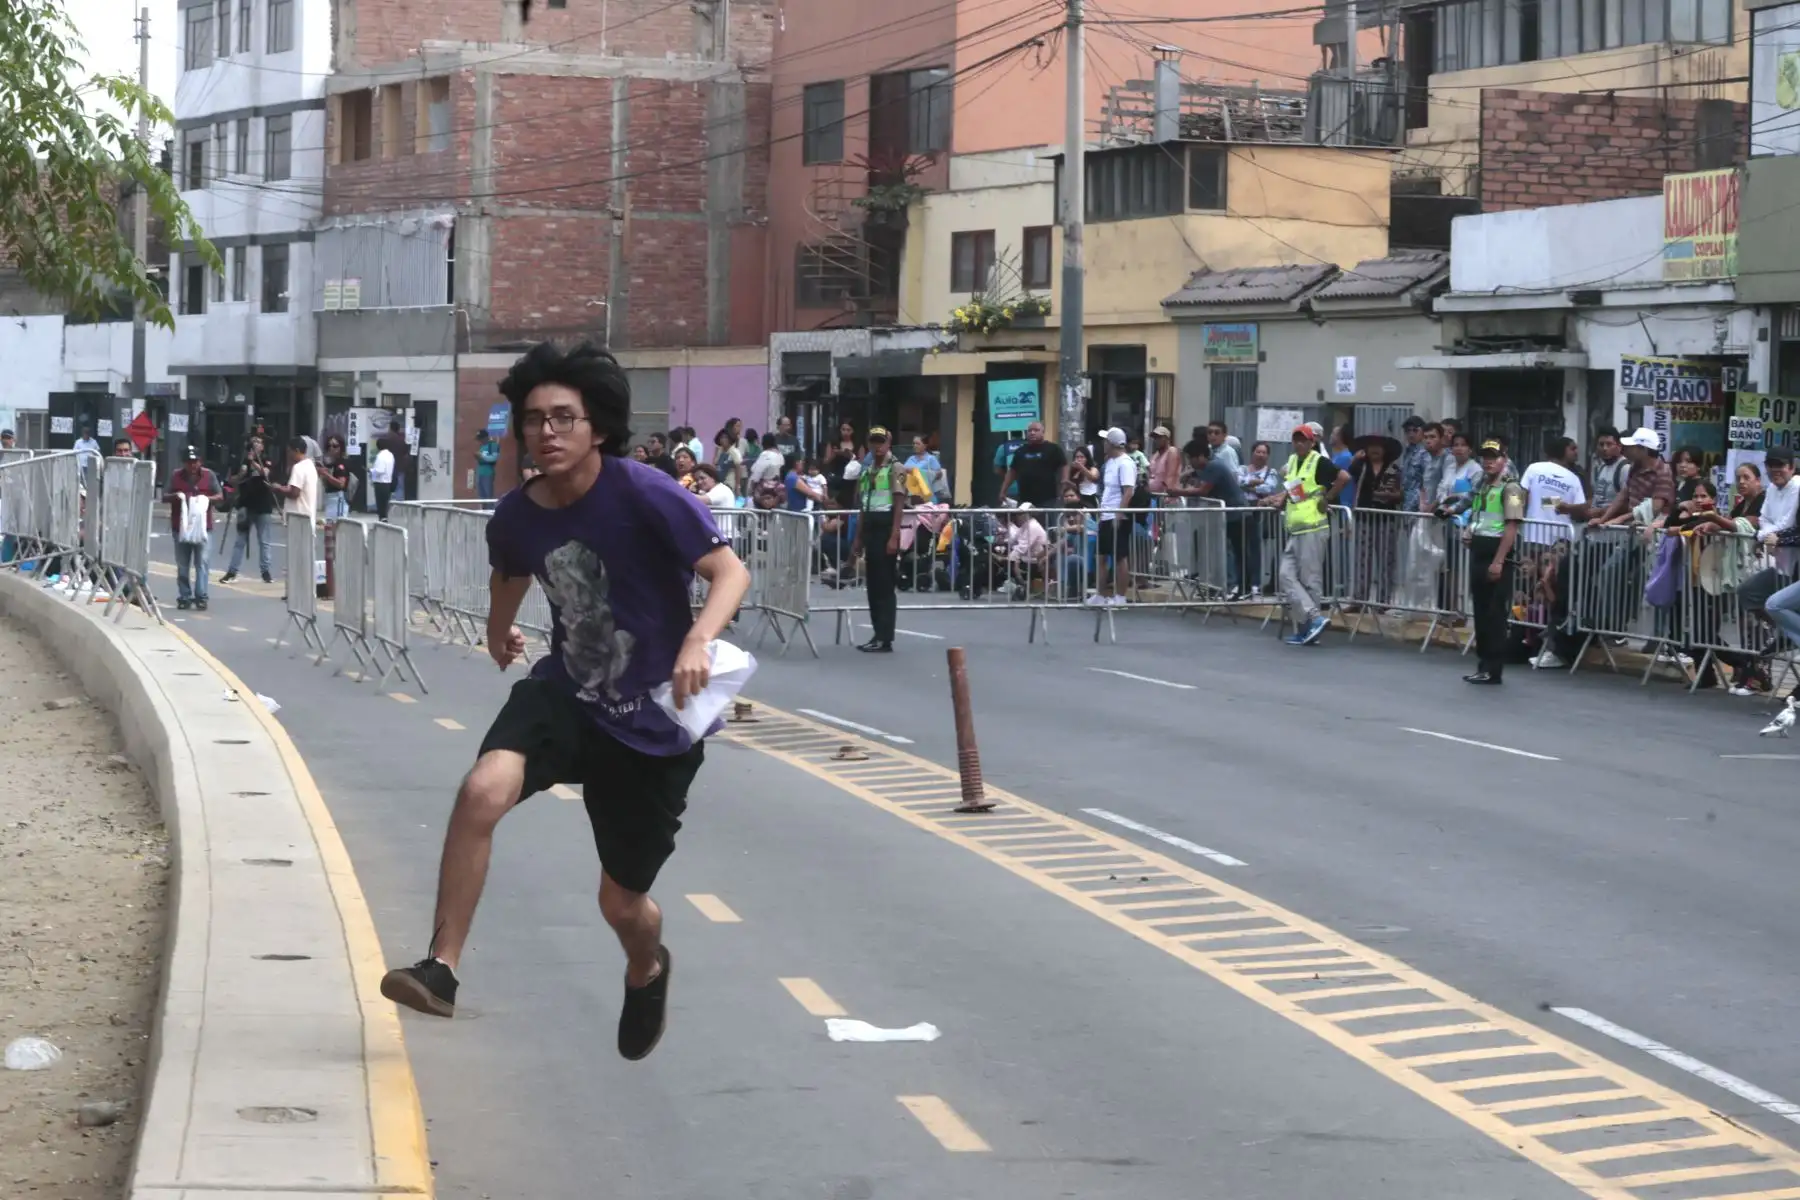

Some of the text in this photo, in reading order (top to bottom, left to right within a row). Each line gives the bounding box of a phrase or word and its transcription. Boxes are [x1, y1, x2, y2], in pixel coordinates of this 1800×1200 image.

[1655, 378, 1709, 402] BAÑO
[1759, 397, 1800, 426] COP
[1731, 418, 1763, 429] BAÑO
[1730, 429, 1761, 440] BAÑO
